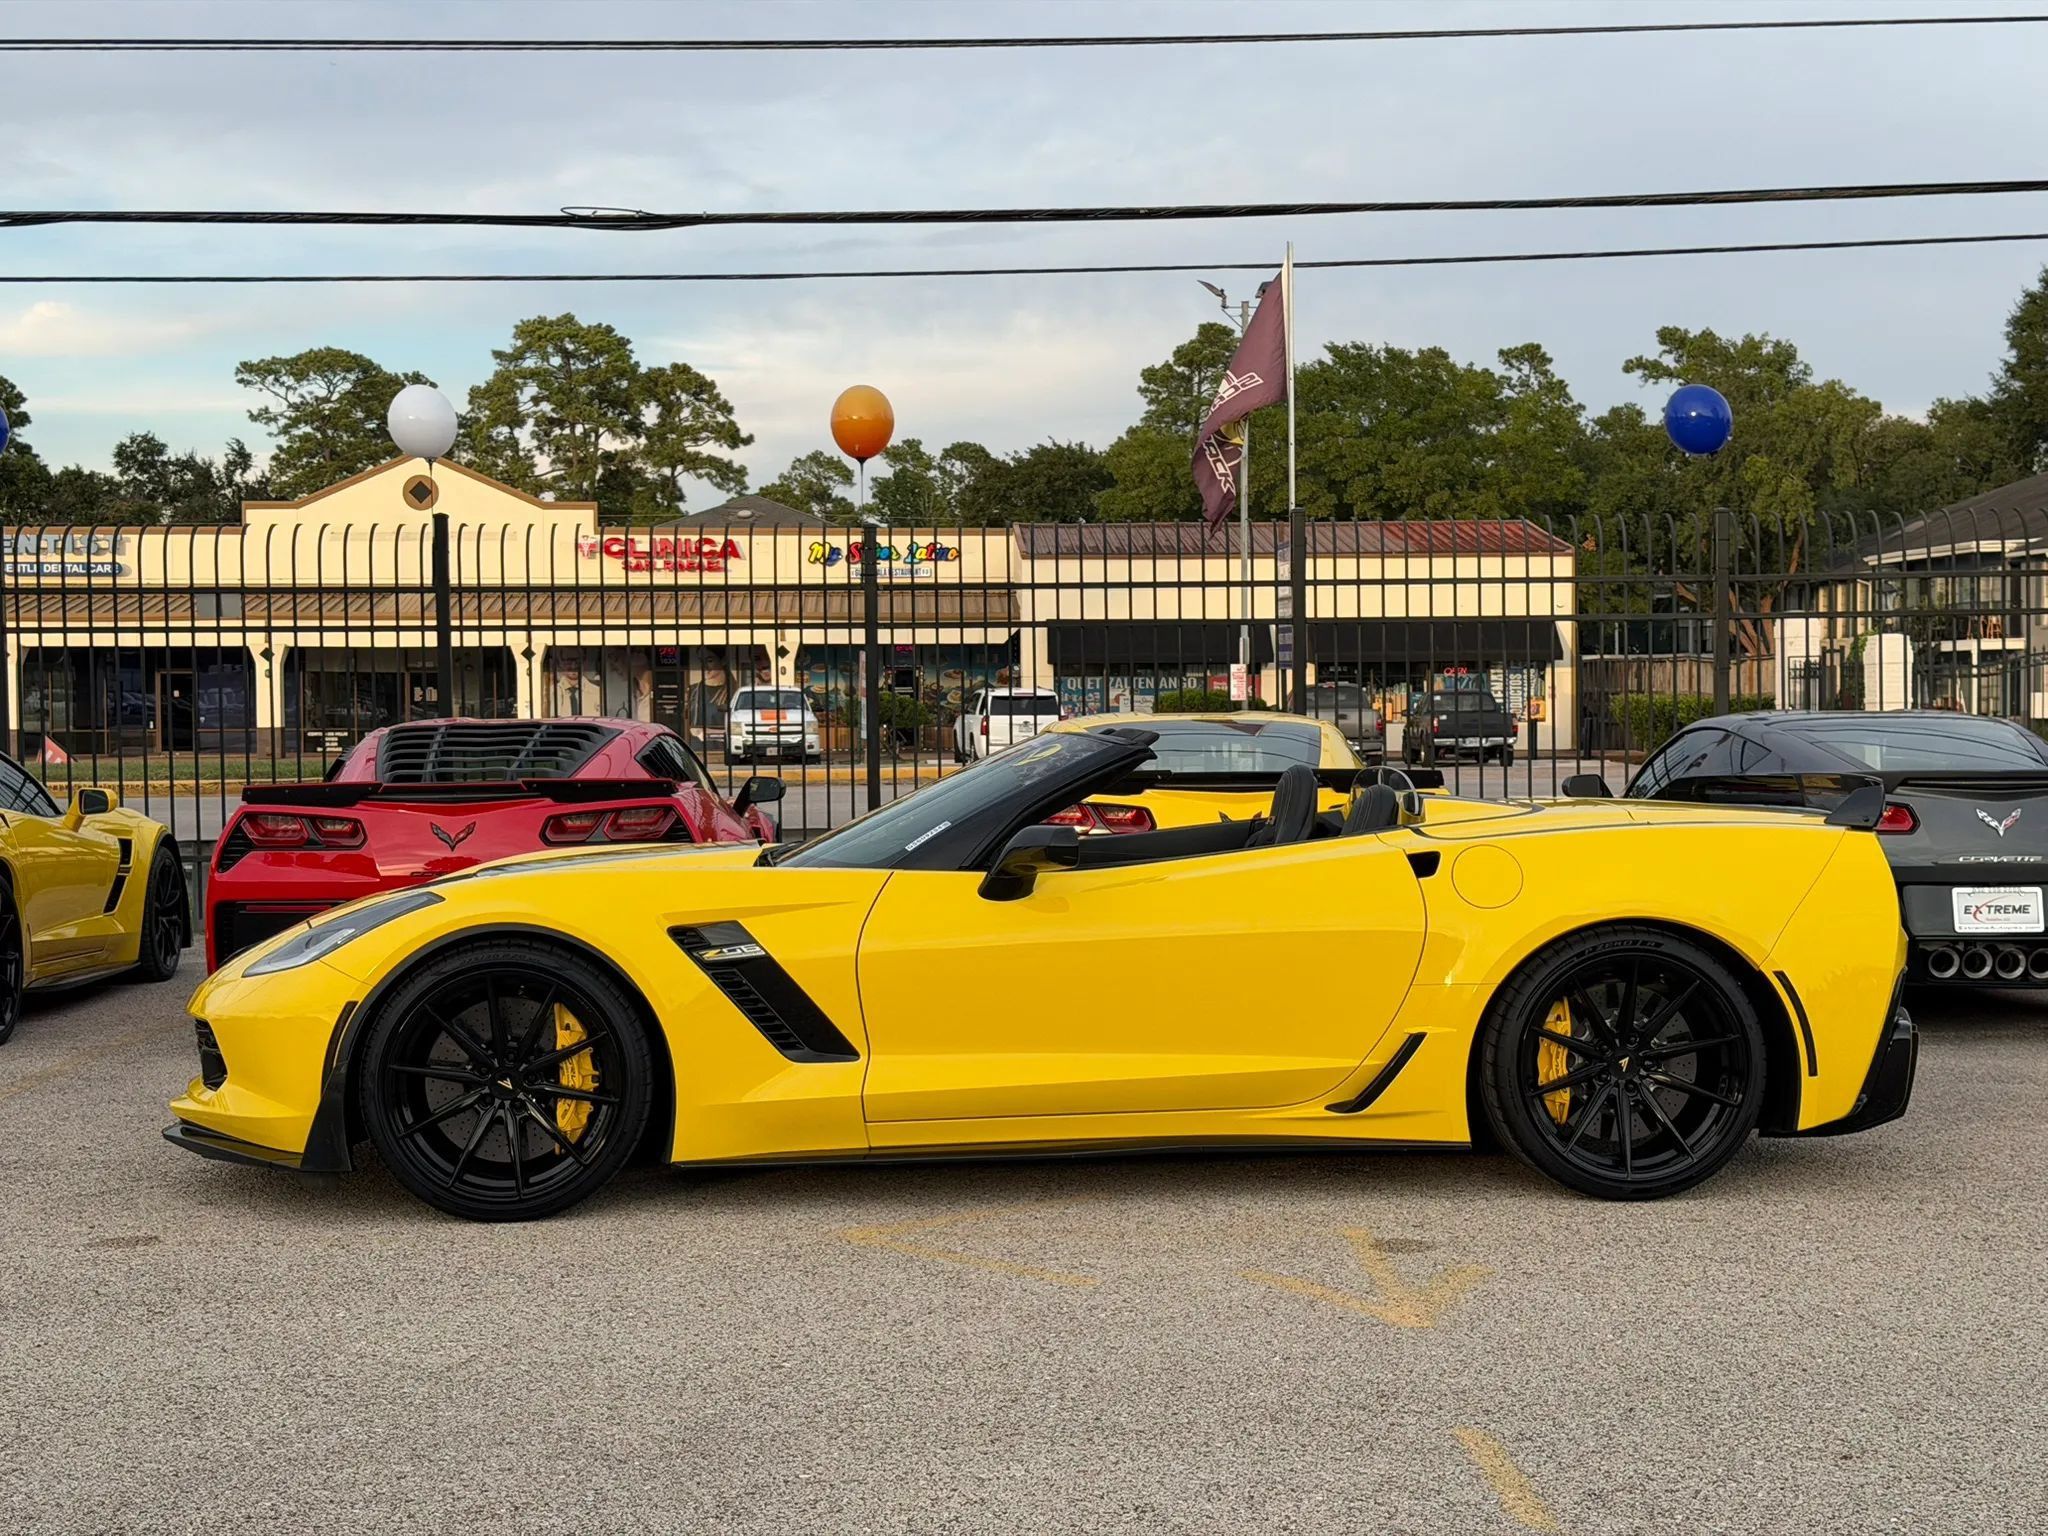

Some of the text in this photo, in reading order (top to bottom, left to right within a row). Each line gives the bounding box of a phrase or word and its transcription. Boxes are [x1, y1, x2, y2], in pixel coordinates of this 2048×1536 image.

[1203, 440, 1236, 496] ACK
[603, 537, 741, 559] CLINICA
[1964, 904, 2031, 915] EXTREME
